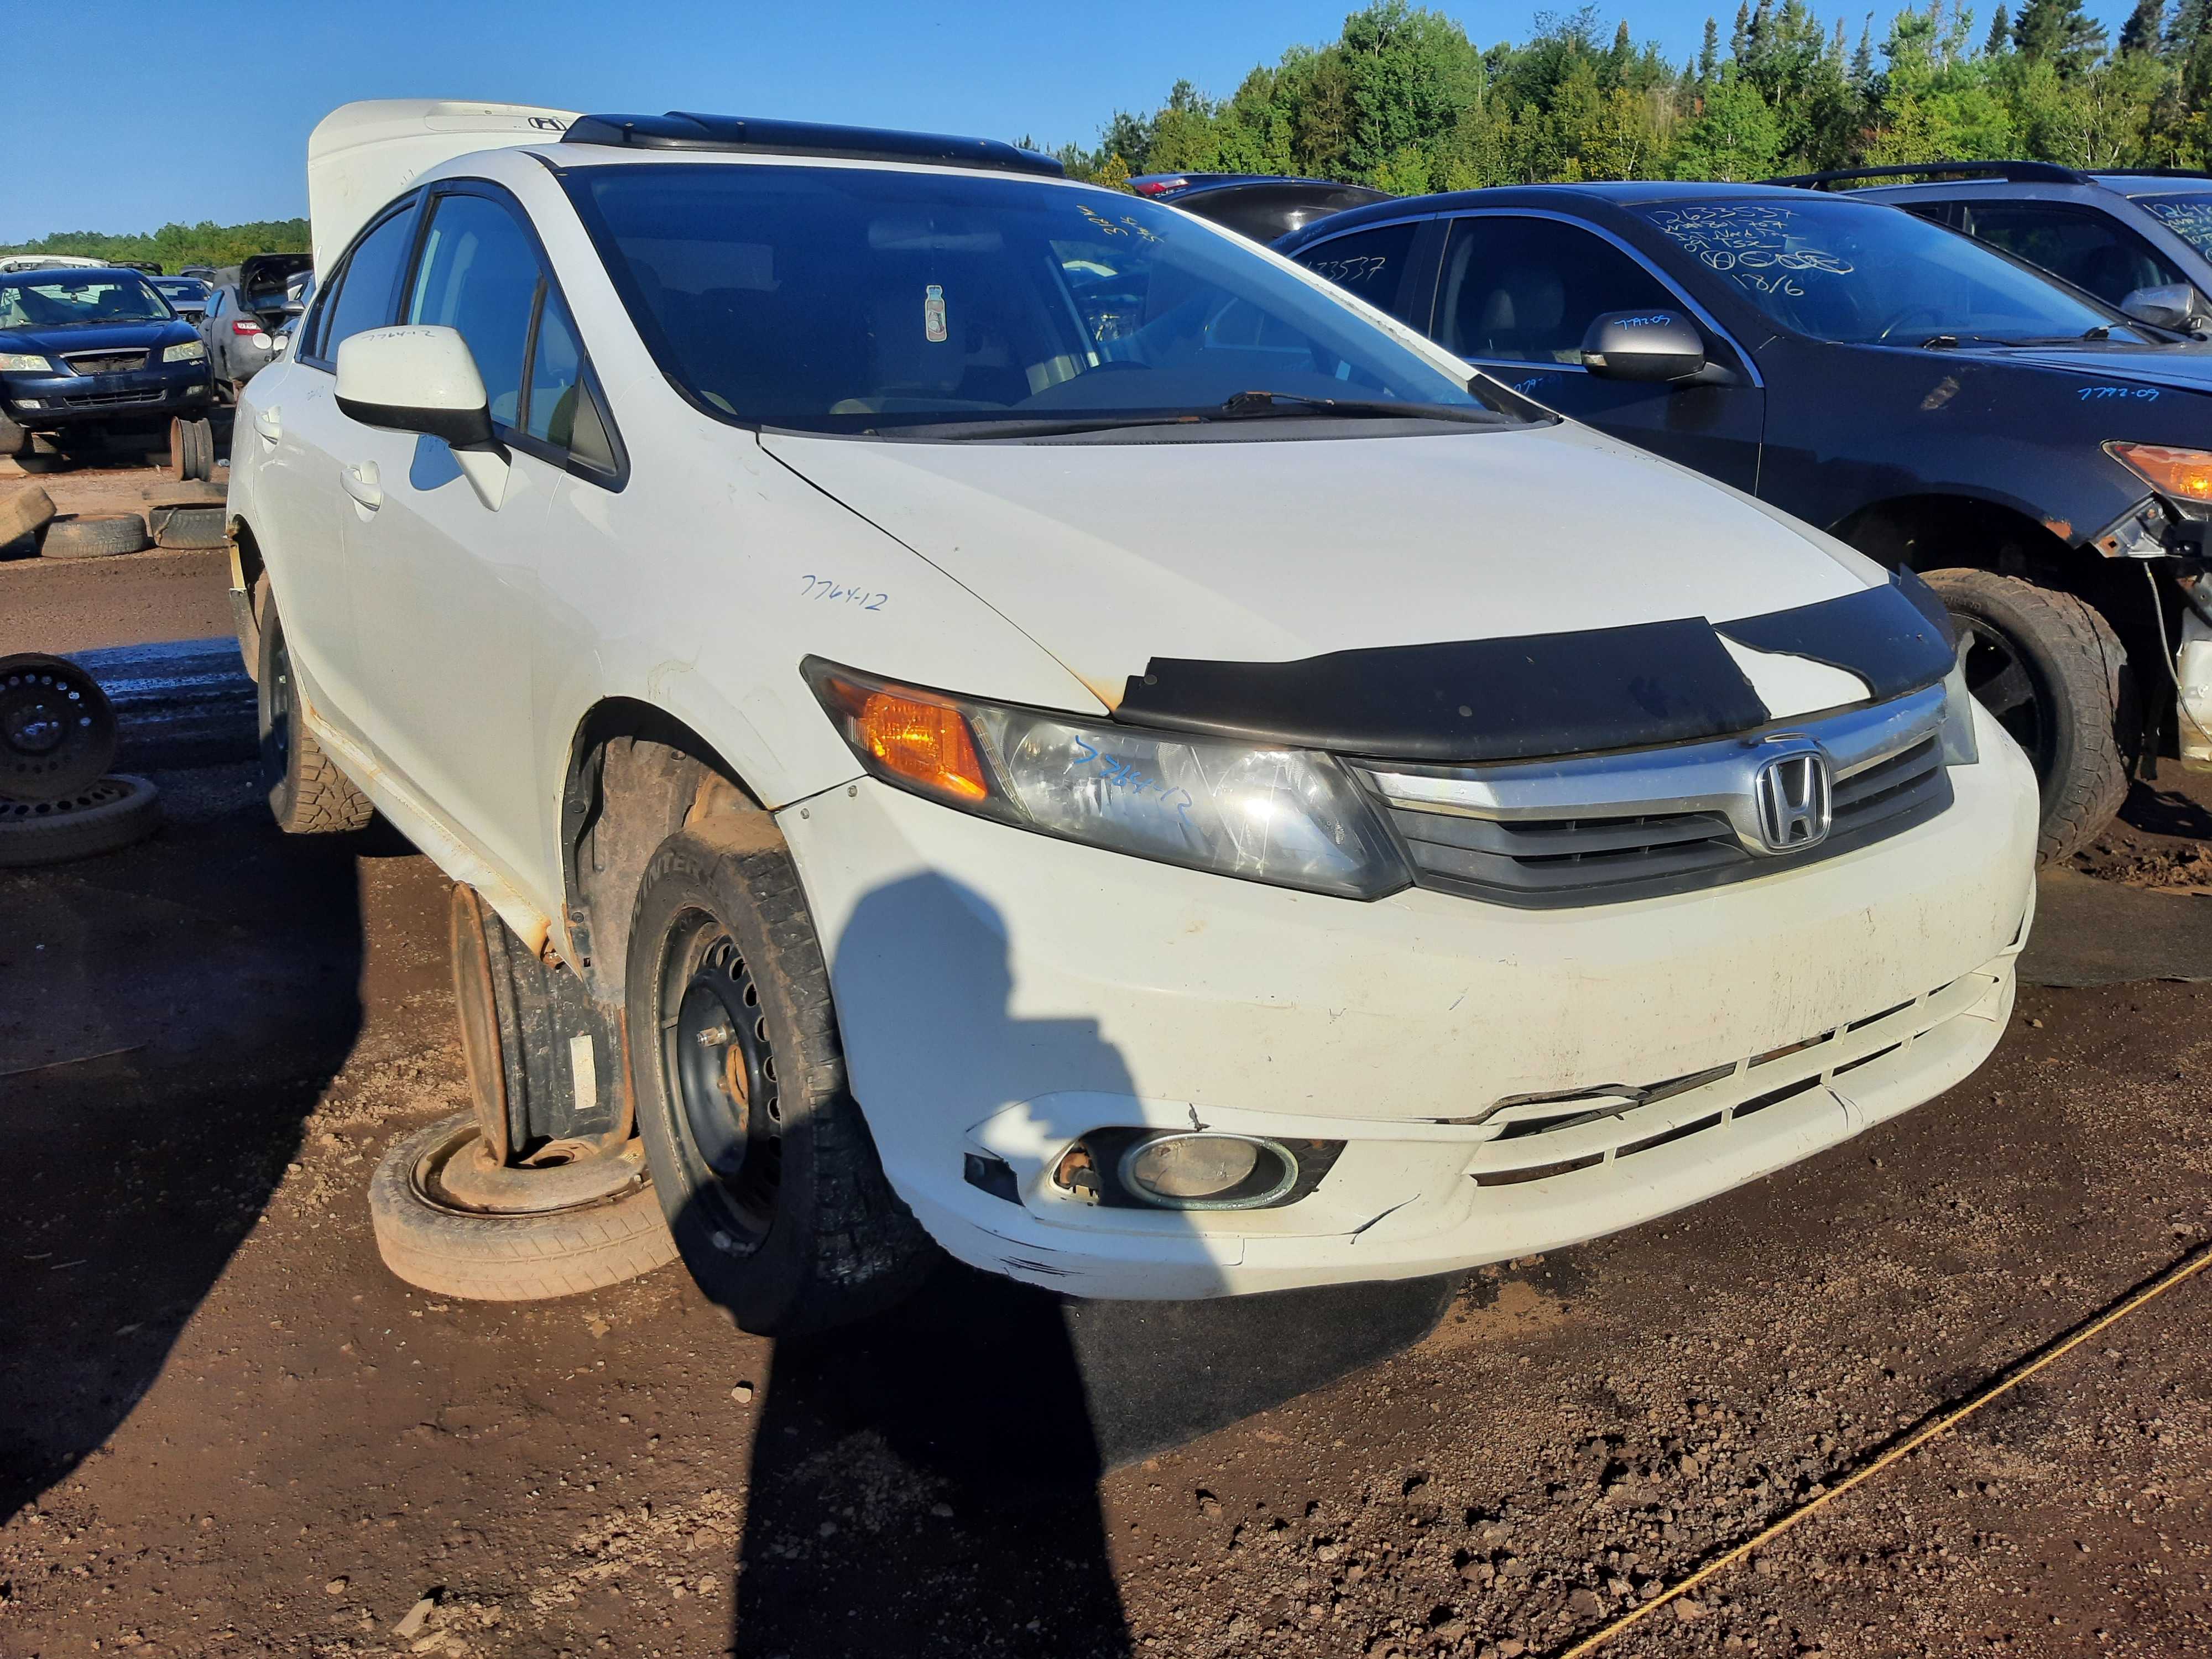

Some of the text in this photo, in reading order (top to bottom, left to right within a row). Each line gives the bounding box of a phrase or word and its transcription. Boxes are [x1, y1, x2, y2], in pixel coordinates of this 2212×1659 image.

[1645, 206, 1801, 225] 12633537
[2078, 387, 2159, 402] 7792-09
[801, 575, 888, 611] 7764-12
